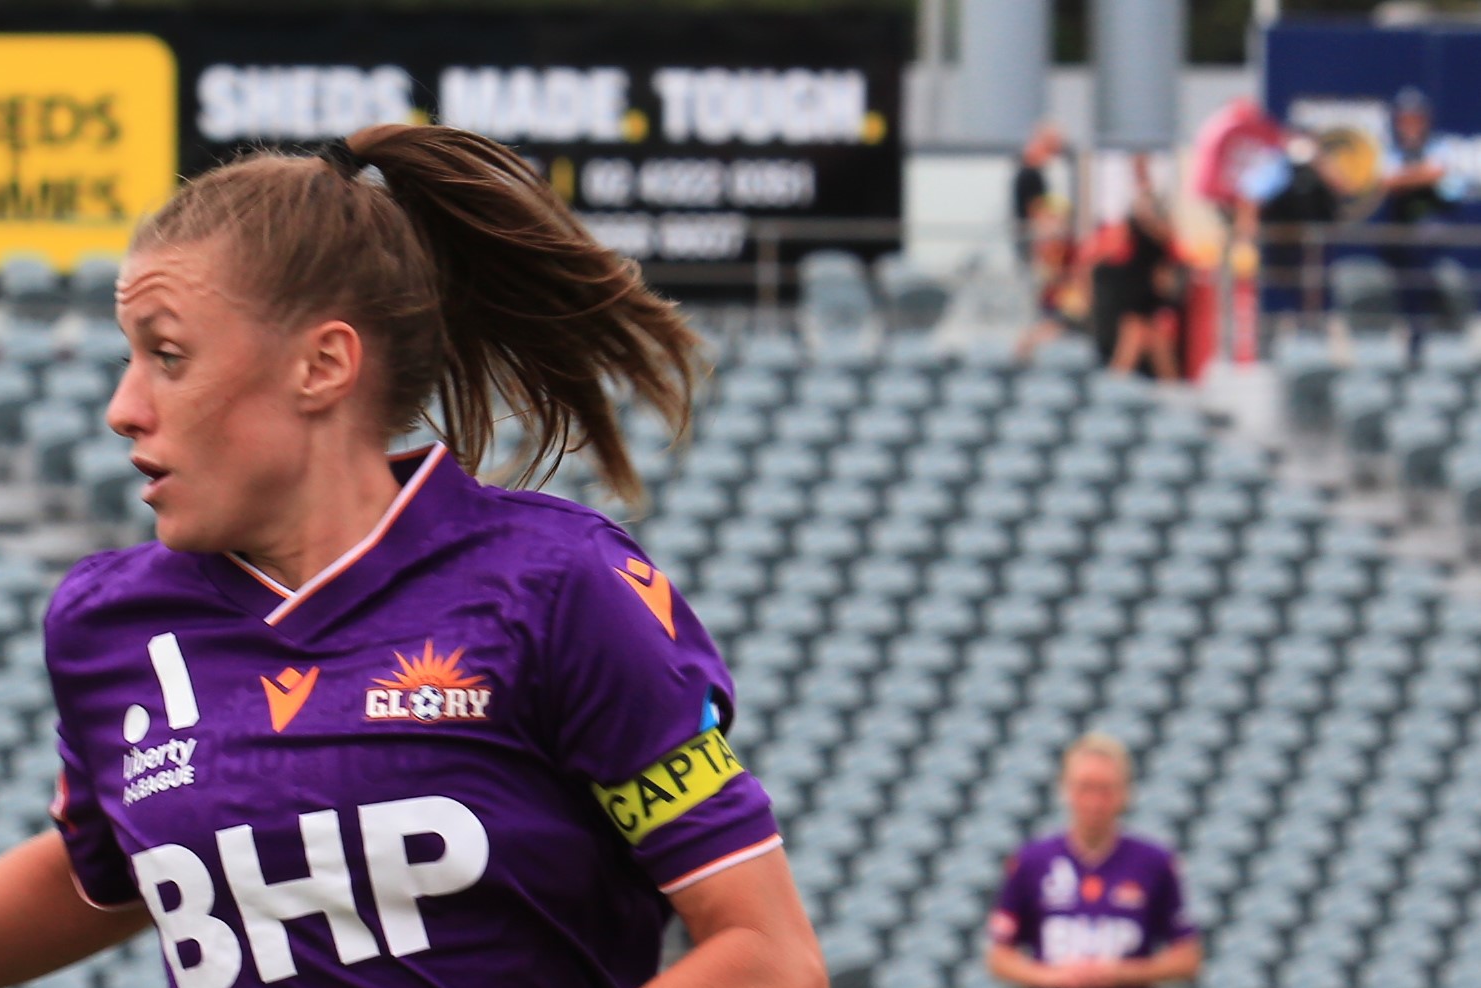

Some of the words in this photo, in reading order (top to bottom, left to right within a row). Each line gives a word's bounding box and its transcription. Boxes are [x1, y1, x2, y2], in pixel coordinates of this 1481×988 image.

[654, 68, 886, 145] TOUGH.
[123, 738, 198, 782] Liberty
[608, 731, 737, 833] CAPTA
